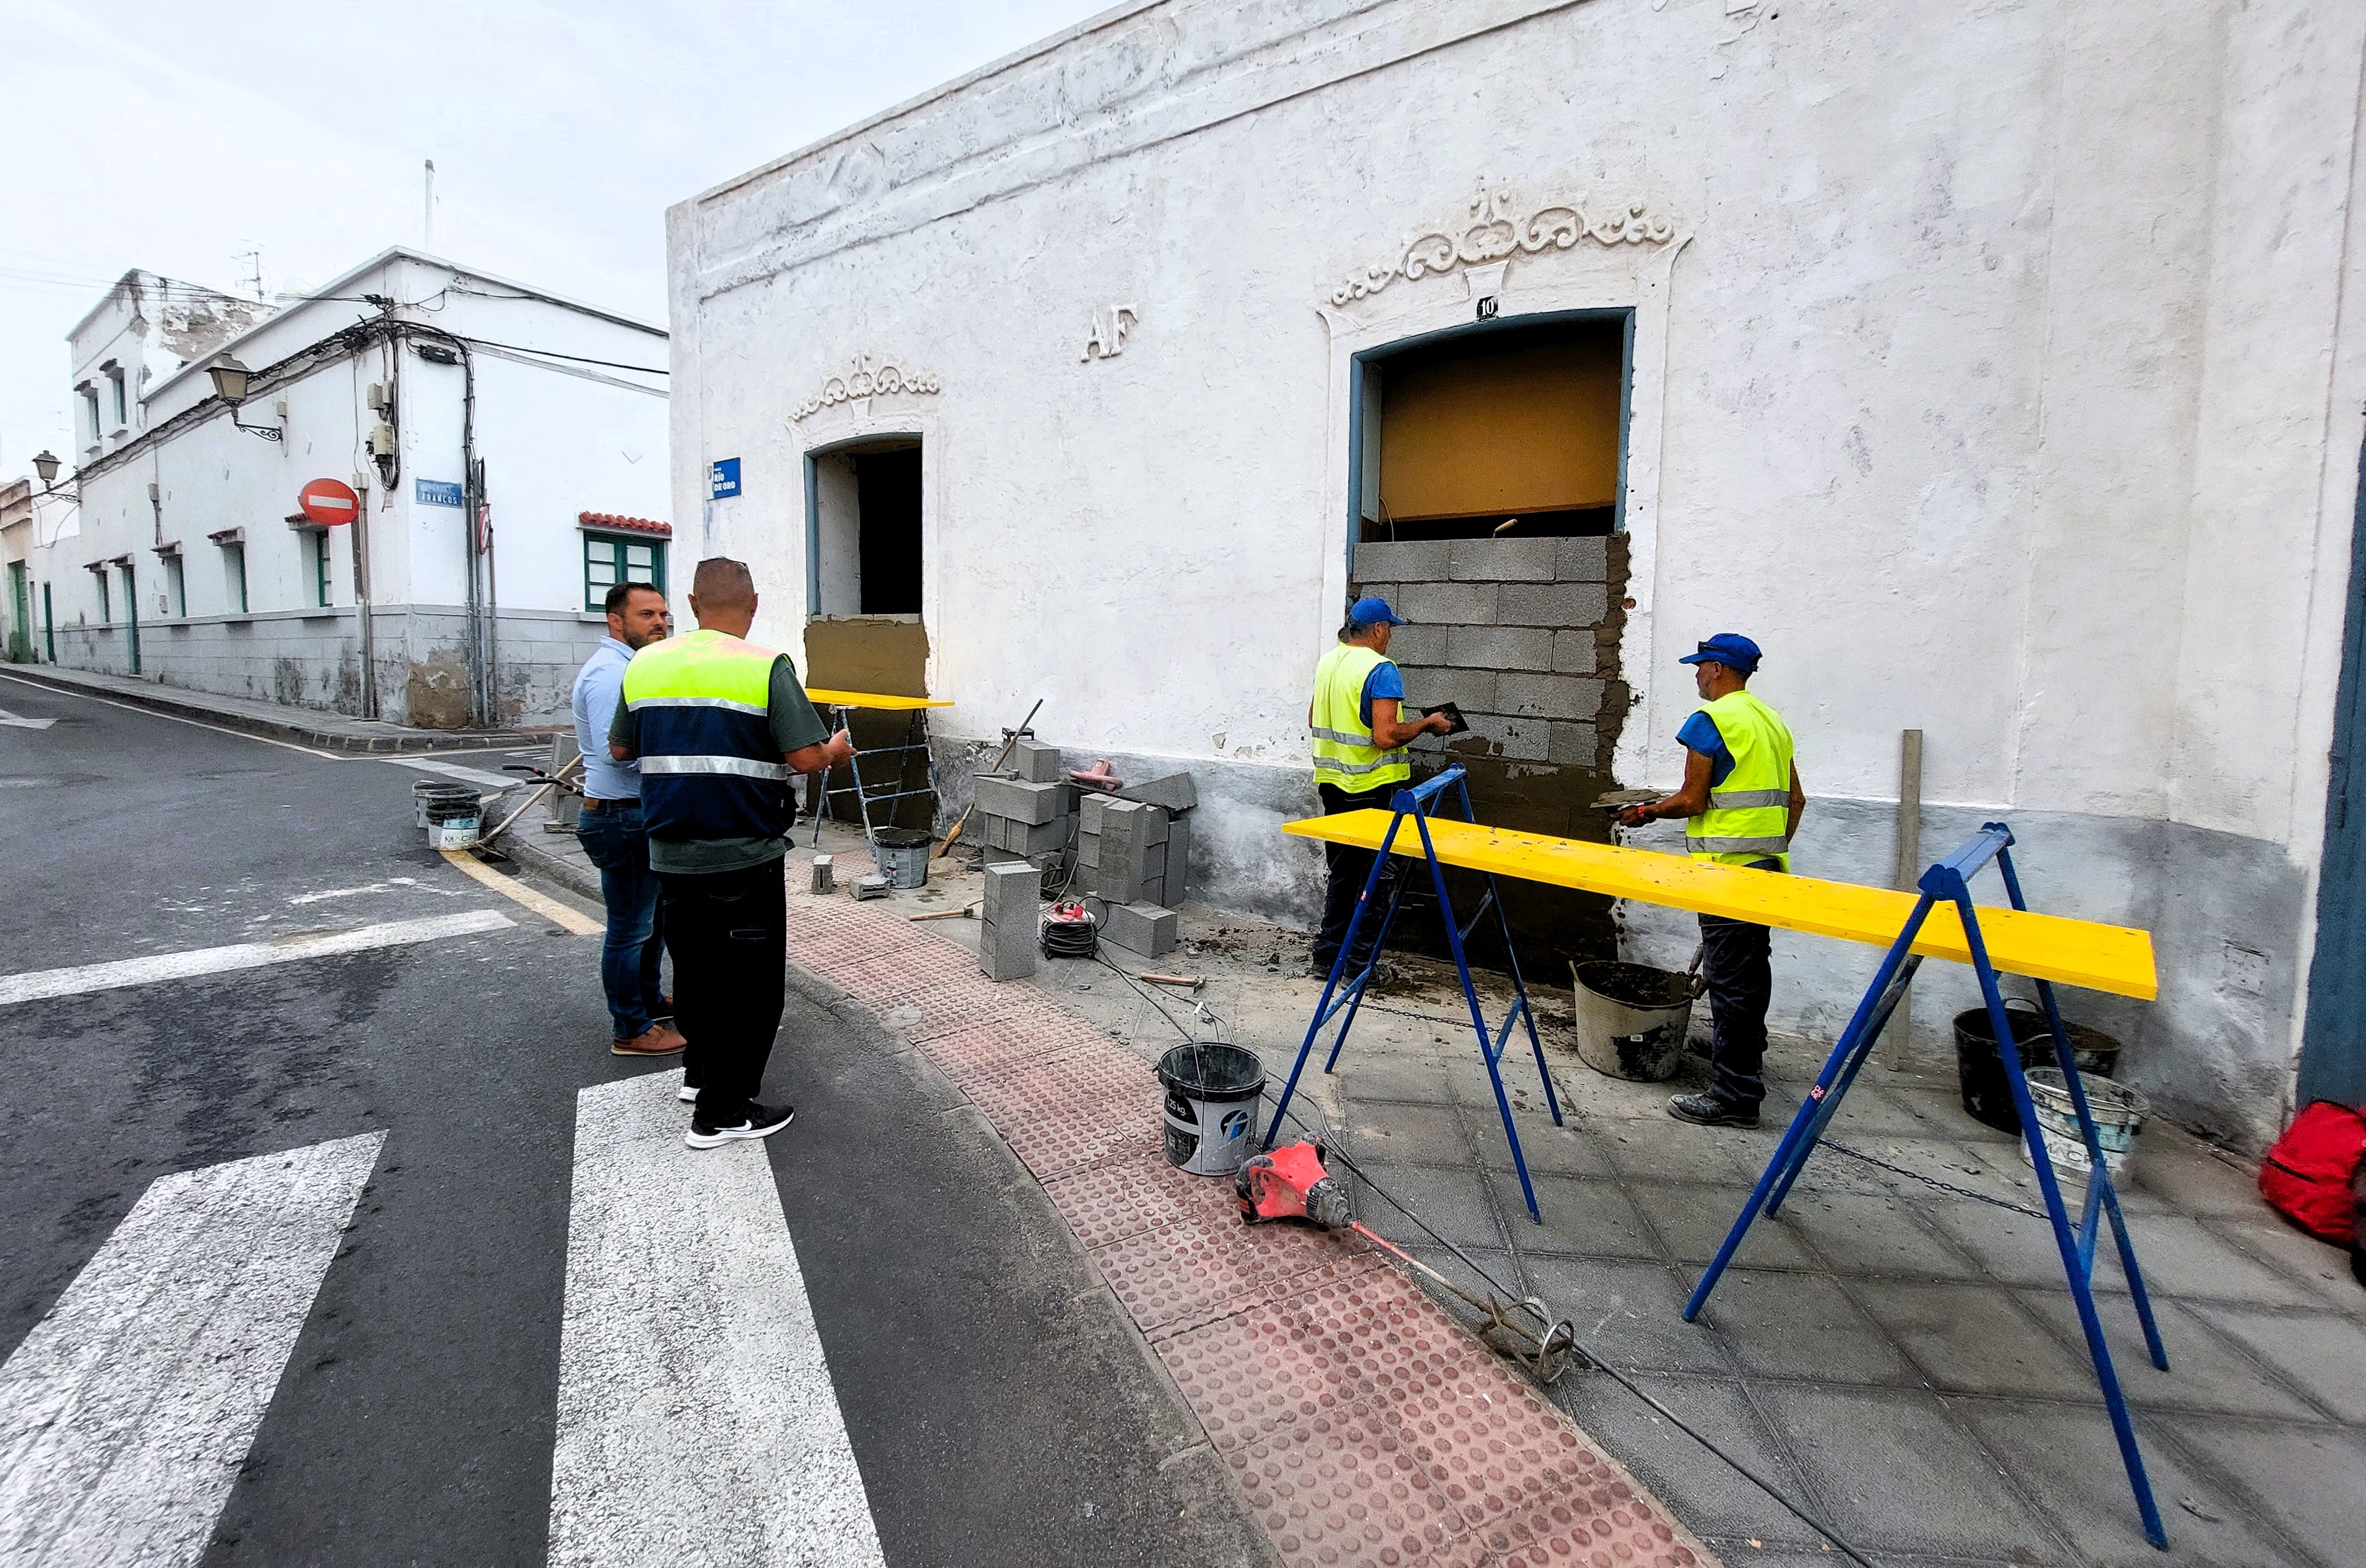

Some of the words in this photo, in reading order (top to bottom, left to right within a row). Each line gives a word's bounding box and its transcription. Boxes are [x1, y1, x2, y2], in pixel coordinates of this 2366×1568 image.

[1481, 299, 1494, 316] 10
[1080, 303, 1138, 363] AF
[714, 472, 725, 482] RÍO
[714, 483, 722, 492] DE
[722, 481, 736, 490] ORO
[1169, 1098, 1176, 1110] 25
